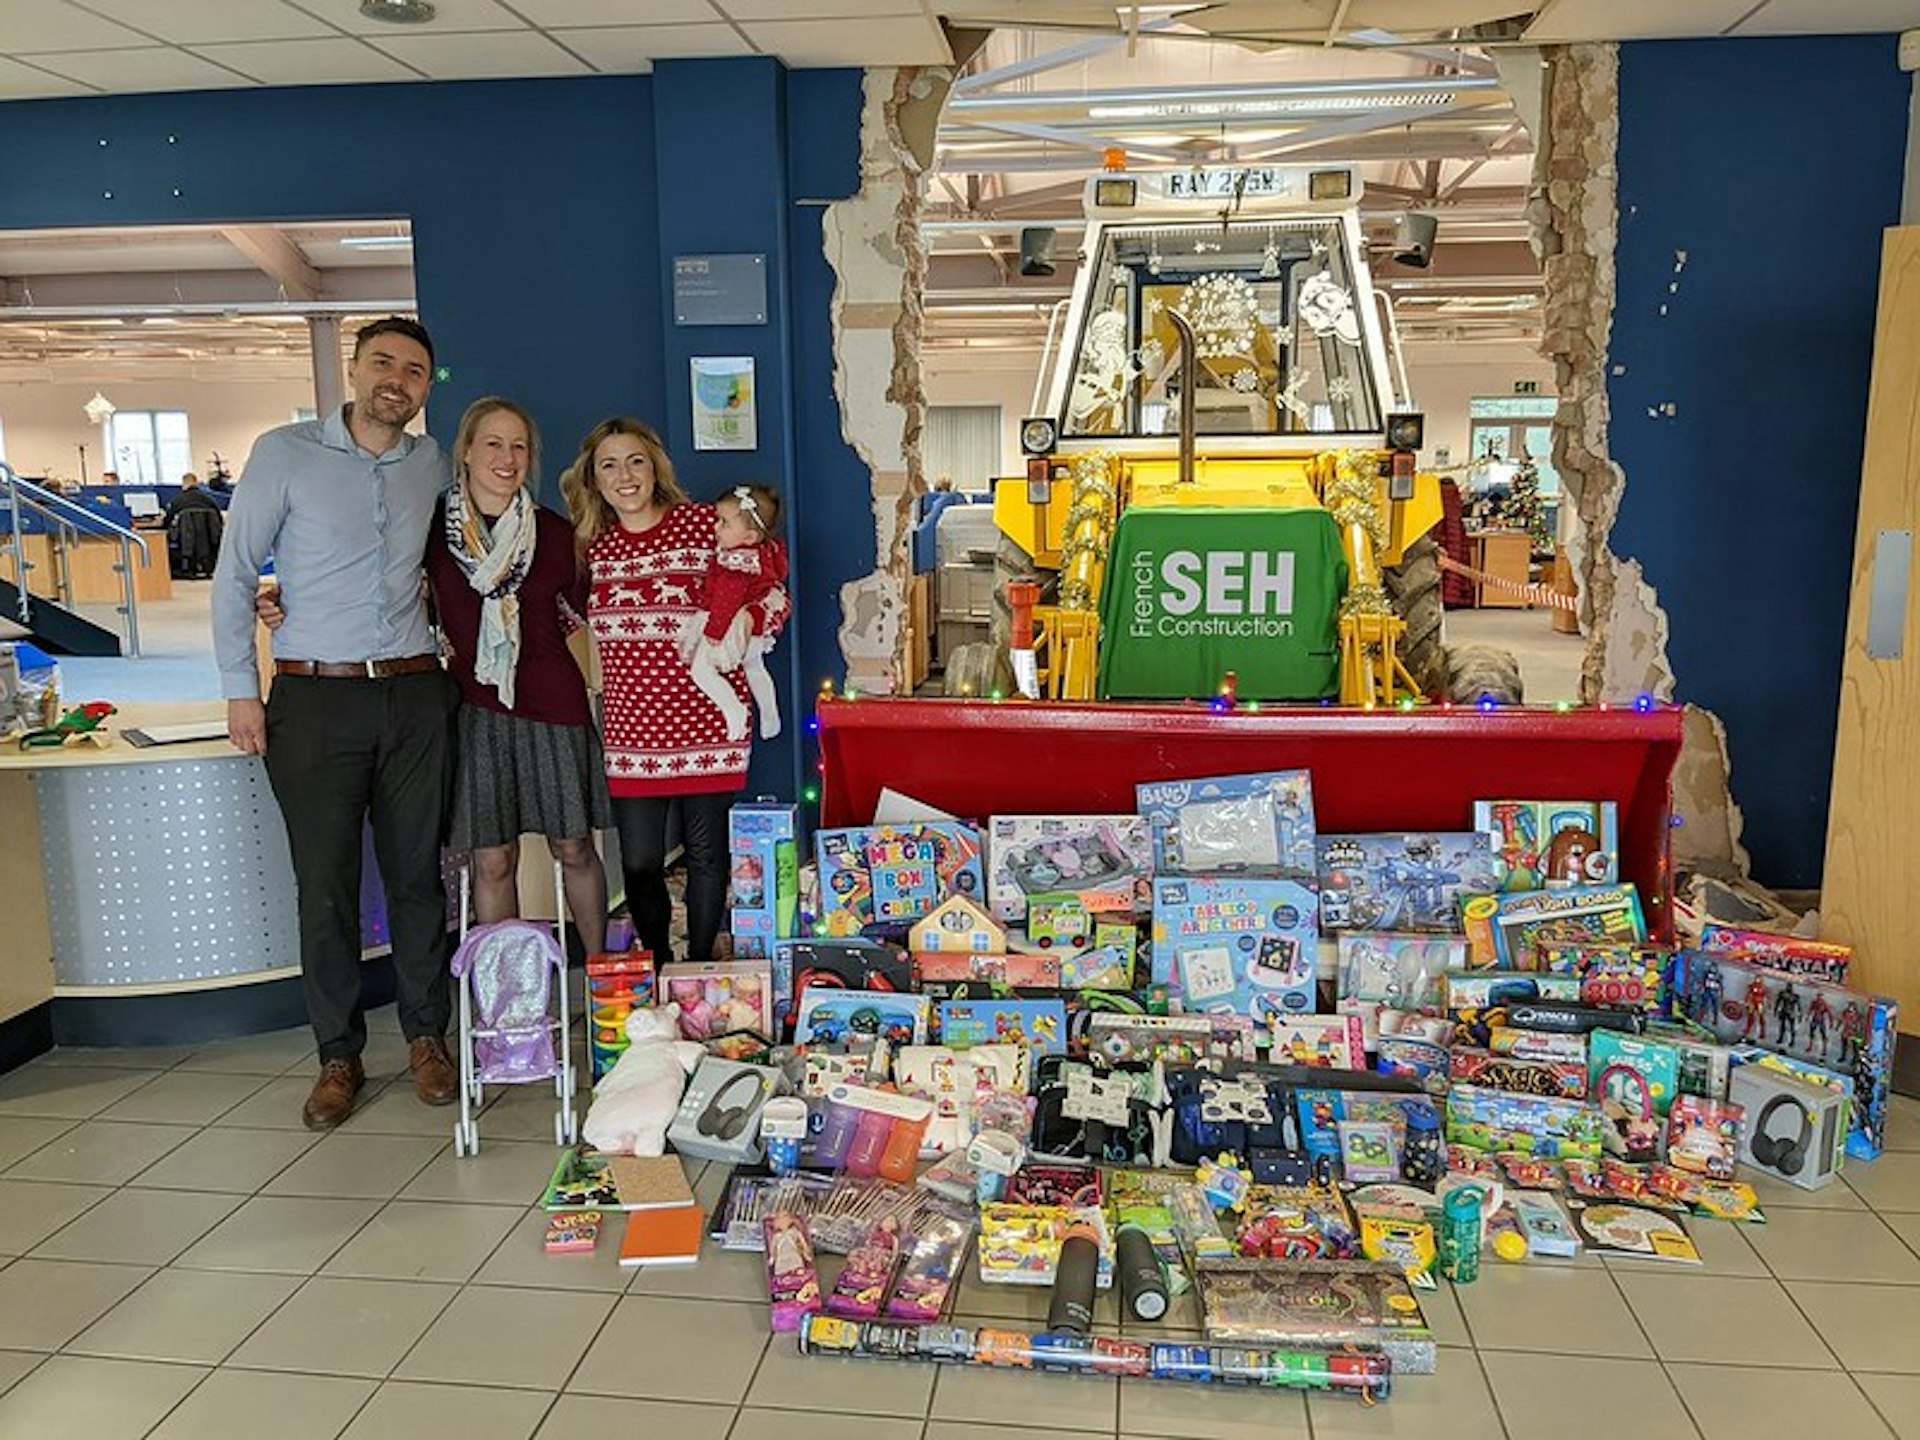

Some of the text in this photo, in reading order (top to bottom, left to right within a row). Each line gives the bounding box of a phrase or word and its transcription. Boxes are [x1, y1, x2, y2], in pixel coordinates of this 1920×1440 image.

[1170, 172, 1212, 195] RAY
[1130, 550, 1153, 637] French
[1160, 550, 1295, 615] SEH
[1158, 616, 1294, 637] Construction
[870, 841, 933, 865] MEGA
[885, 869, 922, 888] BOX
[881, 897, 932, 915] CRAFT
